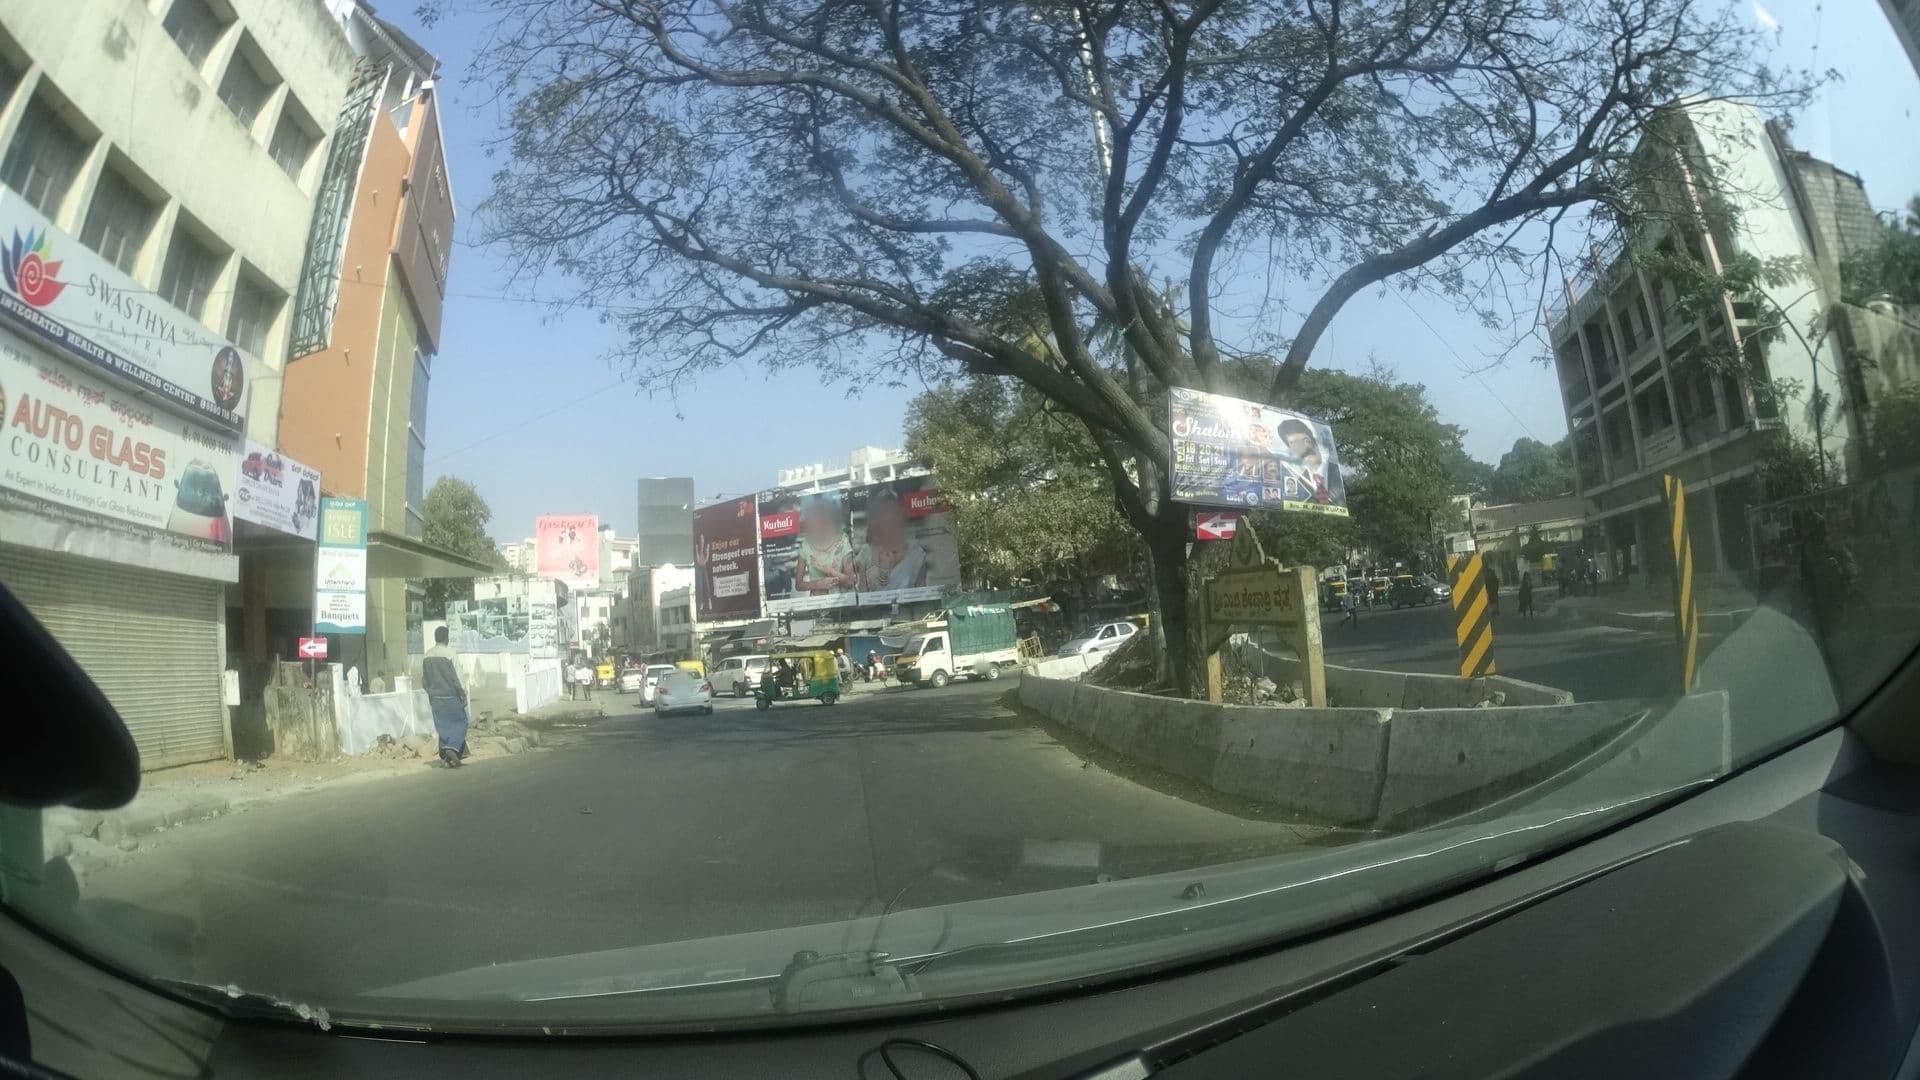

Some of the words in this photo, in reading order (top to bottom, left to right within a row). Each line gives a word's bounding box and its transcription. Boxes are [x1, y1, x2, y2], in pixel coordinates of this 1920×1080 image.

[86, 273, 176, 346] SWASTHYA
[0, 294, 64, 338] INTEGRATED
[67, 332, 105, 361] HEALTH
[105, 355, 113, 365] &
[115, 357, 161, 388] WELLNESS
[163, 381, 195, 406] CENTRE
[11, 392, 83, 451] AUTO
[89, 425, 166, 481] GLASS
[11, 436, 163, 501] CONSULTANT
[712, 549, 740, 562] Strongest
[321, 610, 359, 622] Banquets
